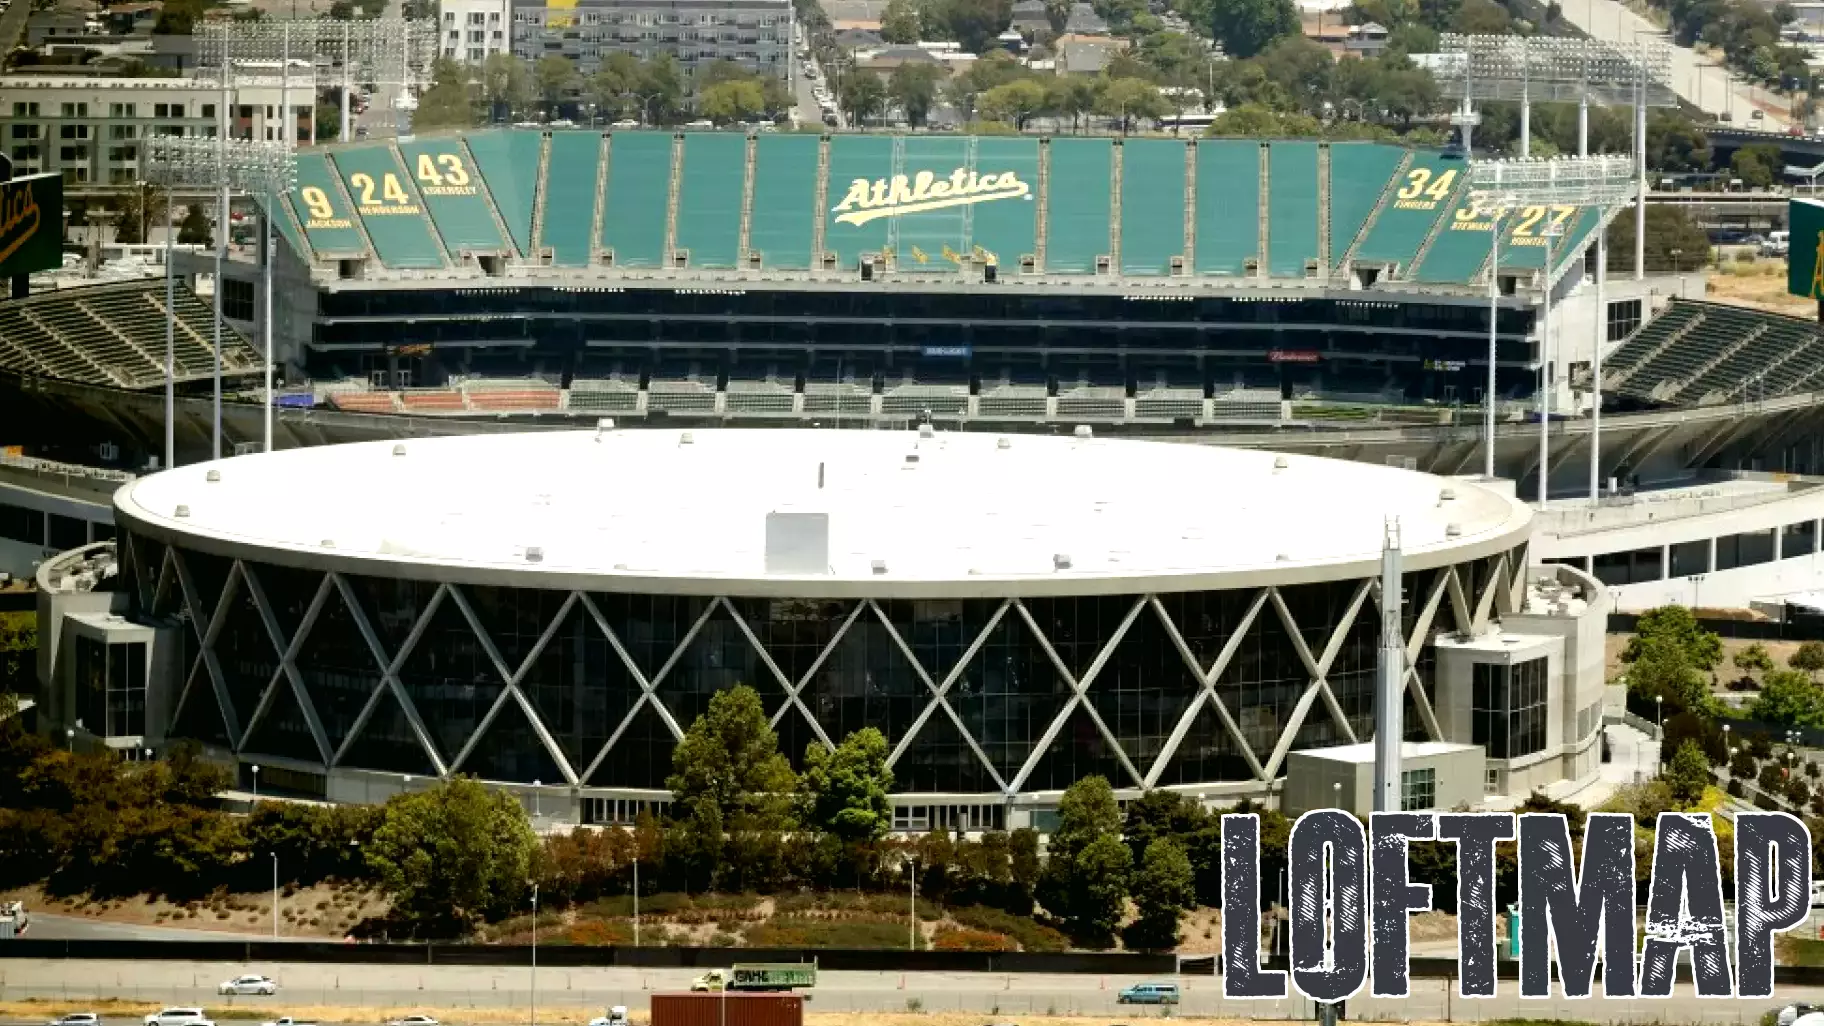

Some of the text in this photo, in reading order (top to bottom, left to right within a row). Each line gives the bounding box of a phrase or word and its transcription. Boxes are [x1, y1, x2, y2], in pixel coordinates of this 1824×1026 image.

[418, 154, 469, 186] 43
[1398, 168, 1457, 200] 34
[302, 186, 334, 218] 9
[351, 173, 409, 205] 24
[831, 167, 1031, 224] Athletics
[1512, 206, 1575, 237] 27
